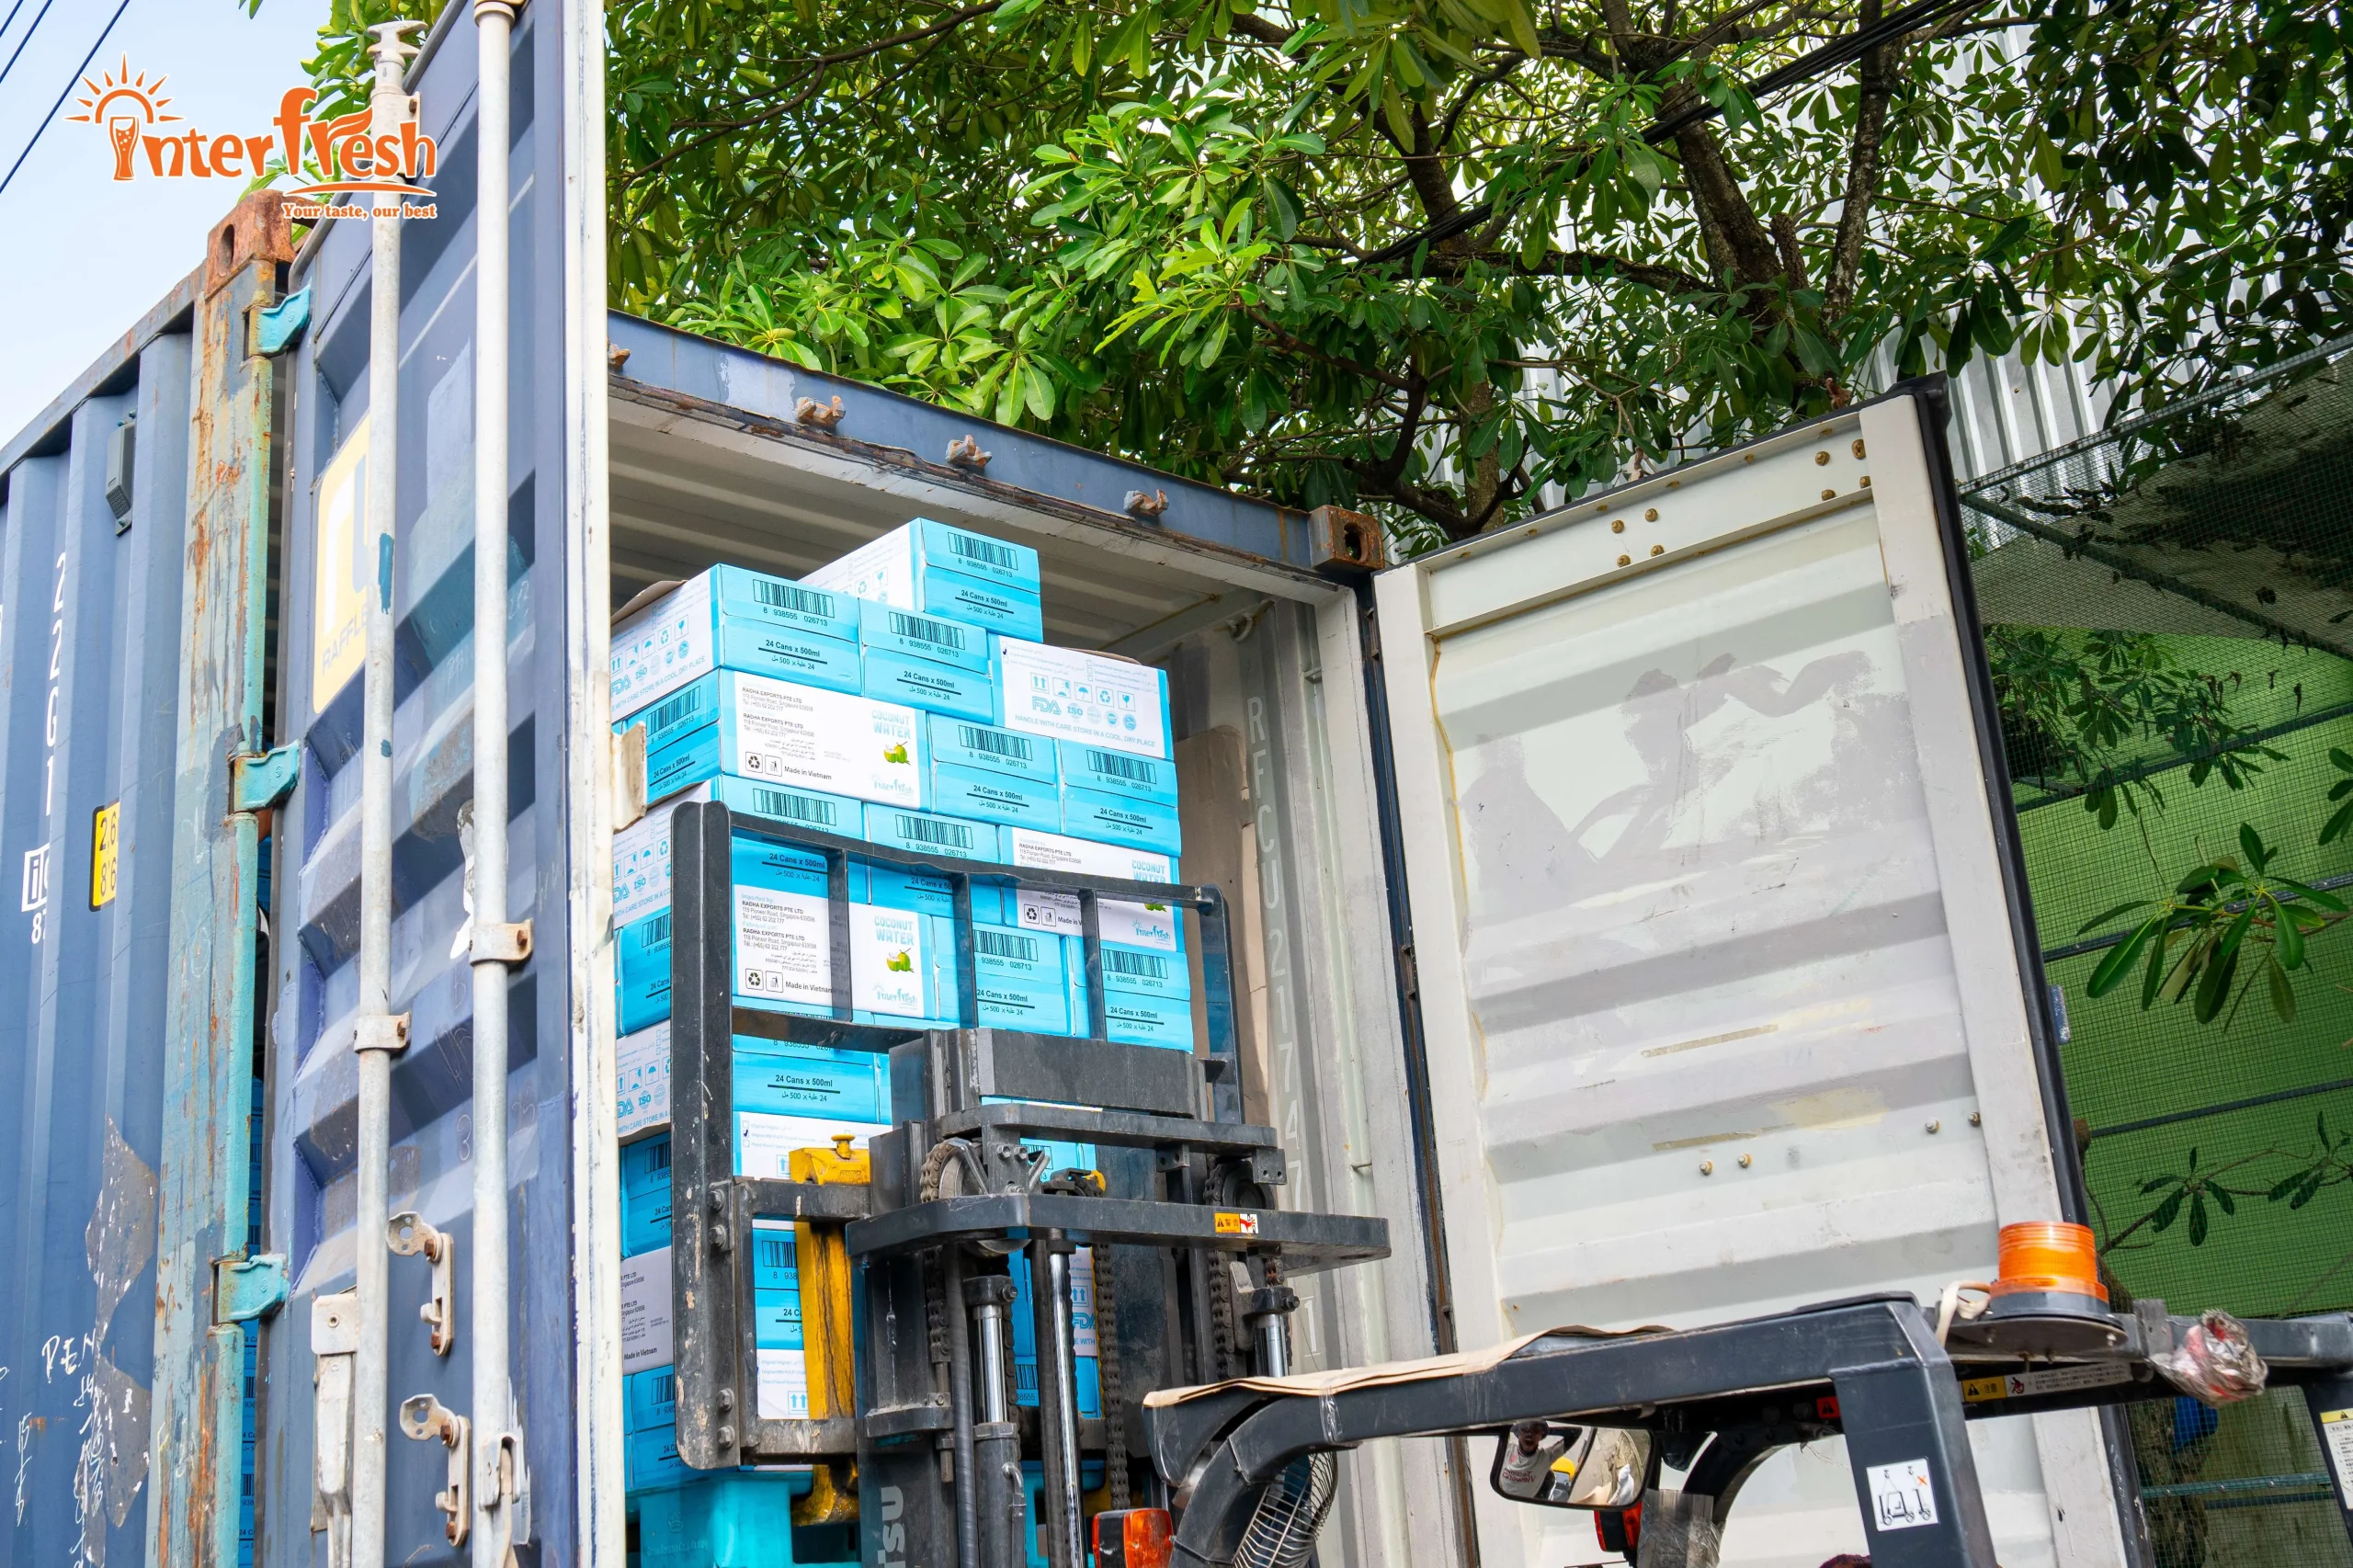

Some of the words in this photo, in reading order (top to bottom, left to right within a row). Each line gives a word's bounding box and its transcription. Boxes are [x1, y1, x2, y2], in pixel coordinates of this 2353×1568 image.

[970, 592, 985, 602] Cans
[991, 597, 1007, 607] 500ml
[323, 602, 368, 676] RAFFLE
[776, 642, 792, 652] Cans
[801, 647, 820, 657] 500ml
[914, 673, 929, 683] Cans
[937, 677, 954, 688] 500ml
[1031, 697, 1062, 716] FDA
[1067, 706, 1084, 716] ISO
[871, 710, 909, 725] COCONUT
[873, 722, 911, 739] WATER
[1015, 714, 1040, 725] HANDLE
[1040, 719, 1055, 727] WITH
[1056, 722, 1072, 731] CARE
[1074, 725, 1092, 734] STORE
[1124, 735, 1136, 744] DRY
[1137, 737, 1155, 747] PLACE
[660, 766, 672, 775] Cans
[784, 766, 801, 775] Made
[808, 770, 832, 780] Vietnam
[983, 787, 998, 796] Cans
[1005, 791, 1022, 801] 500ml
[1246, 697, 1280, 909] RFCU
[1109, 810, 1123, 818] Cans
[1130, 813, 1146, 823] 500ml
[779, 855, 797, 864] Cans
[805, 858, 825, 869] 500ml
[1131, 859, 1165, 874] COCONUT
[920, 879, 937, 888] Cans
[874, 915, 914, 931] COCONUT
[876, 928, 915, 946] WATER
[986, 990, 1002, 998] Cans
[1009, 994, 1028, 1002] 500ml
[1267, 927, 1302, 1211] 21747
[786, 1075, 803, 1084] Cans
[813, 1078, 833, 1086] 500ml
[639, 1094, 651, 1106] ISO
[630, 1119, 642, 1129] CARE
[642, 1114, 658, 1125] STORE
[624, 1352, 635, 1360] Made
[641, 1347, 657, 1357] Vietnam
